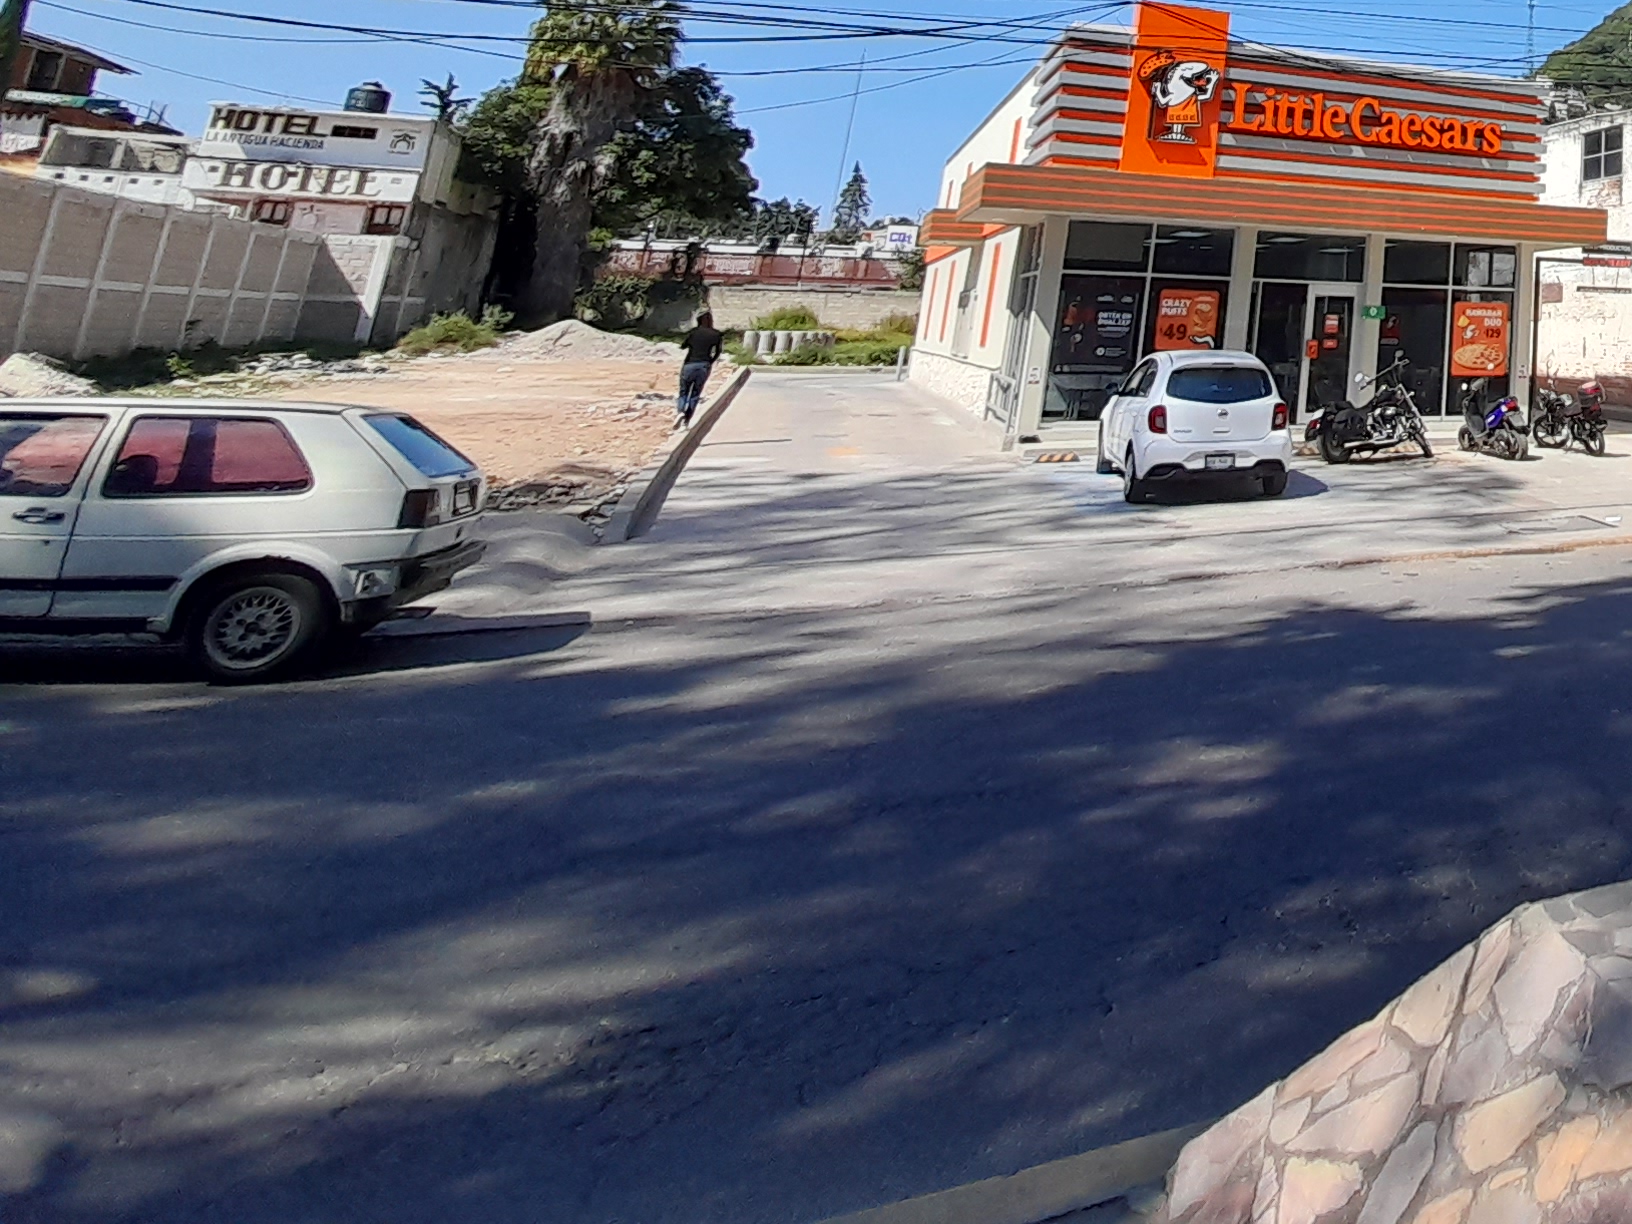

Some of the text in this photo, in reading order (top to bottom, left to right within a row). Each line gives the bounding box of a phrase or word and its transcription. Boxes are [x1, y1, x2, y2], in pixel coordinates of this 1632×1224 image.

[210, 107, 331, 137] HOTEL
[1228, 82, 1503, 155] Little Caesars
[205, 131, 220, 142] LA
[214, 162, 384, 197] HOTEL
[1161, 307, 1188, 316] PUFFS
[1162, 298, 1192, 307] CRAZY
